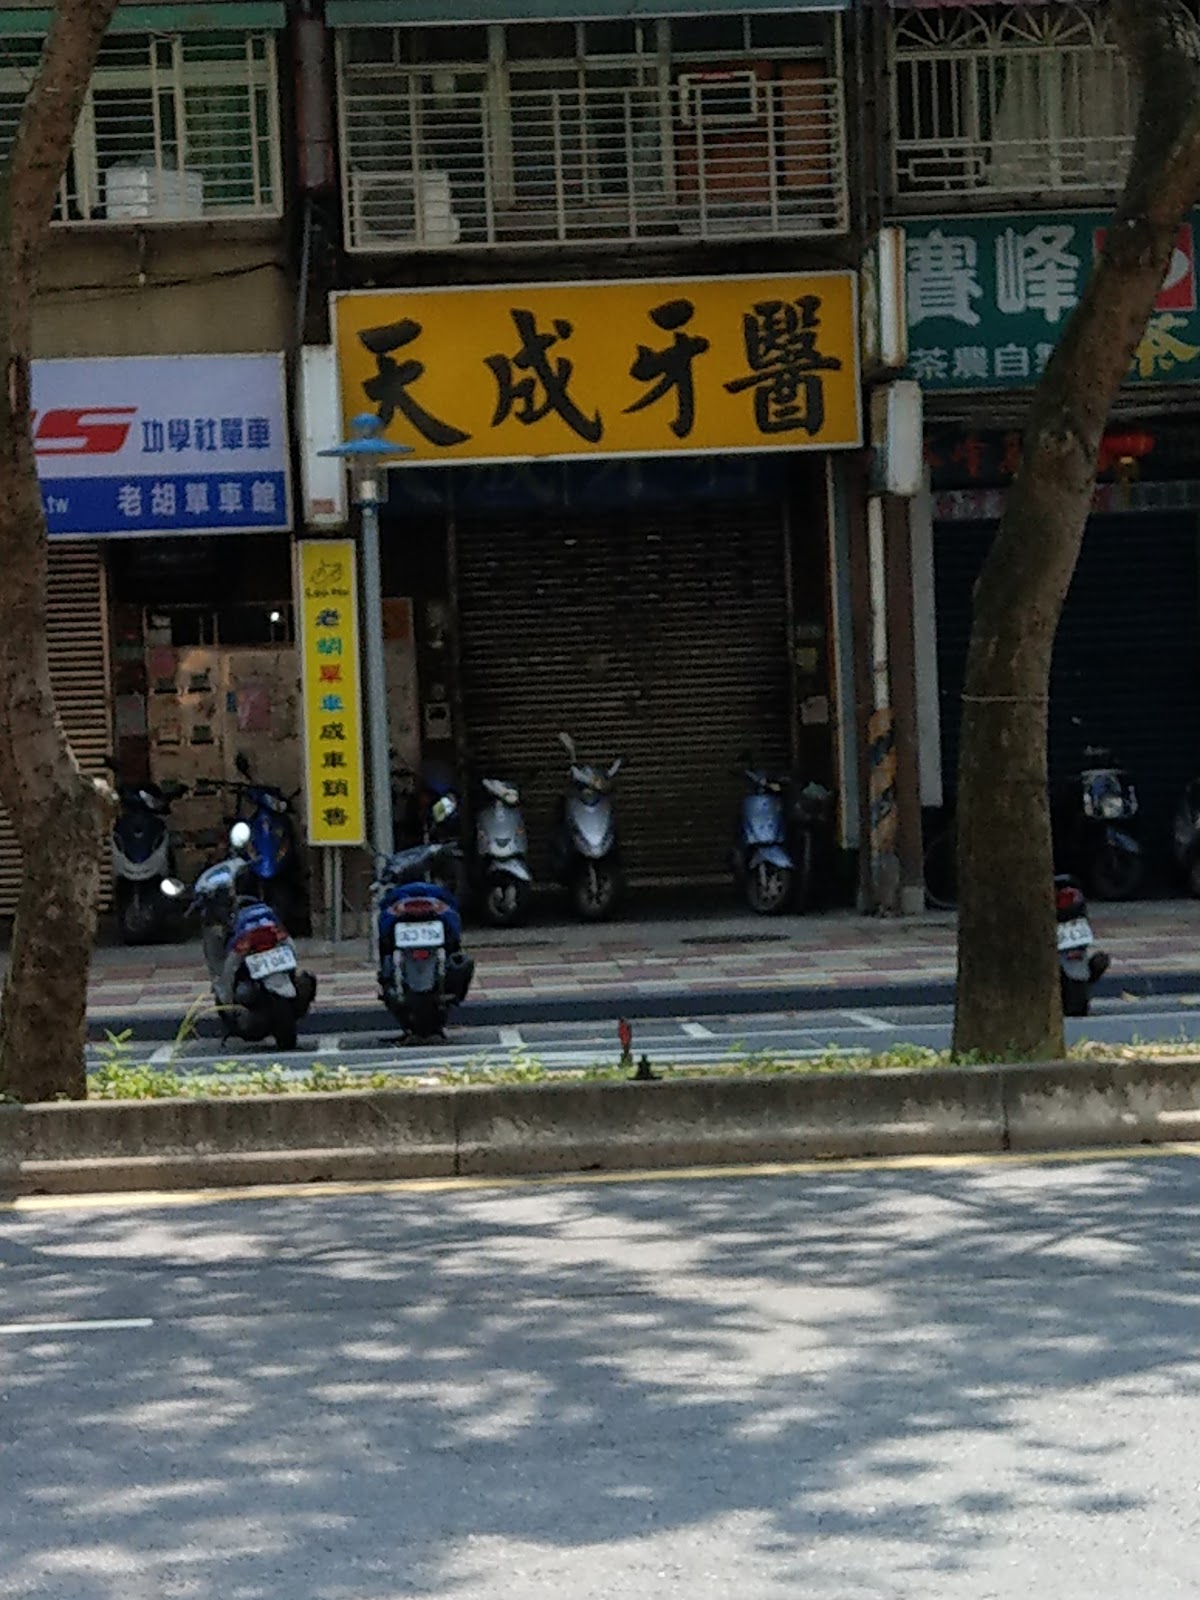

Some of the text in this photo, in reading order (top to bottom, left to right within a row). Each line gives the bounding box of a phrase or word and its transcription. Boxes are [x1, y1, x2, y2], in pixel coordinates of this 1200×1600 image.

[356, 294, 842, 447] 天成牙醫
[30, 407, 138, 455] S
[142, 417, 271, 453] 功學社單車
